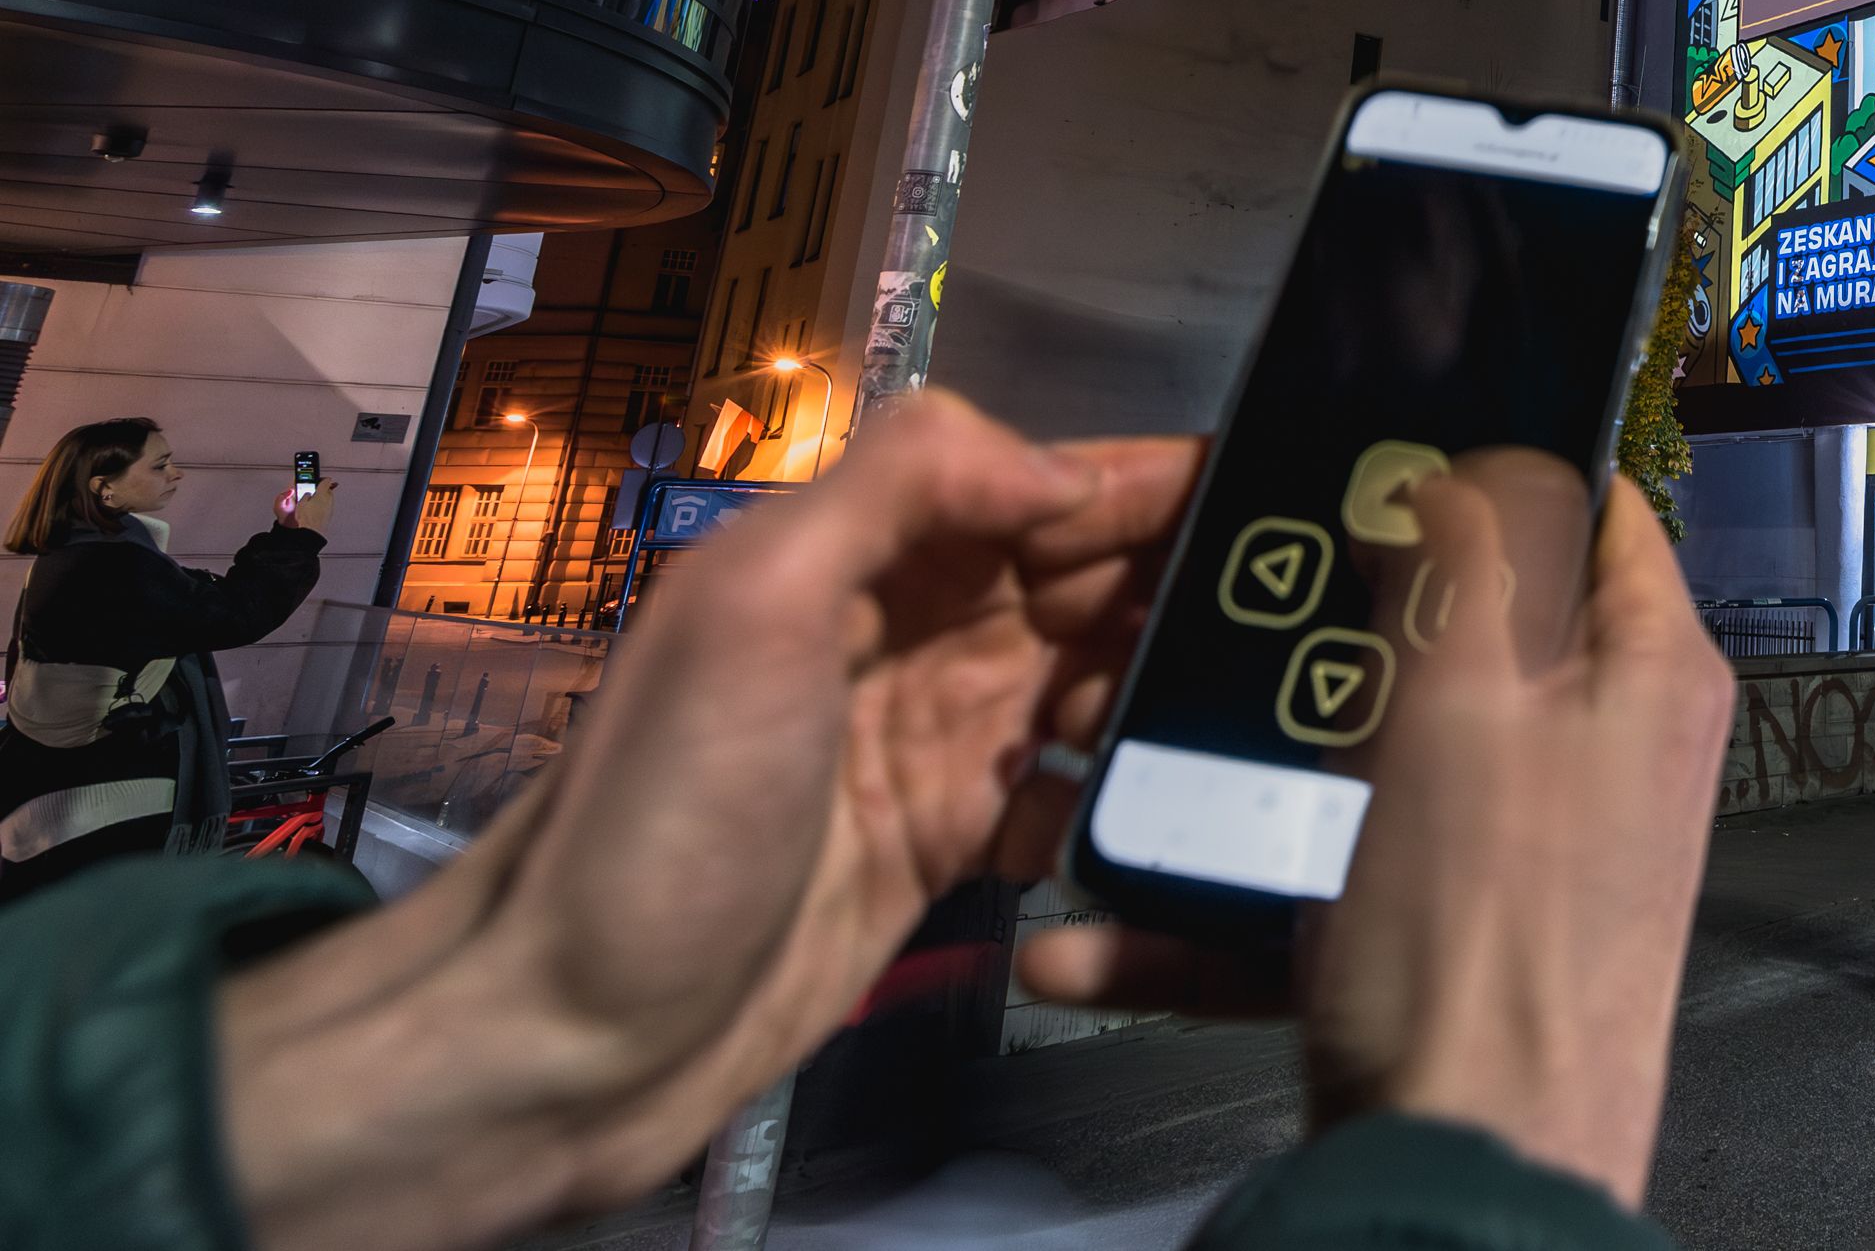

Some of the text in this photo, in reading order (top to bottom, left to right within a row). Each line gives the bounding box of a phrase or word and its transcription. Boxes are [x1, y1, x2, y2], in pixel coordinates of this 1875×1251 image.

[1778, 262, 1784, 285] I
[1777, 290, 1809, 315] NA
[671, 506, 698, 533] P
